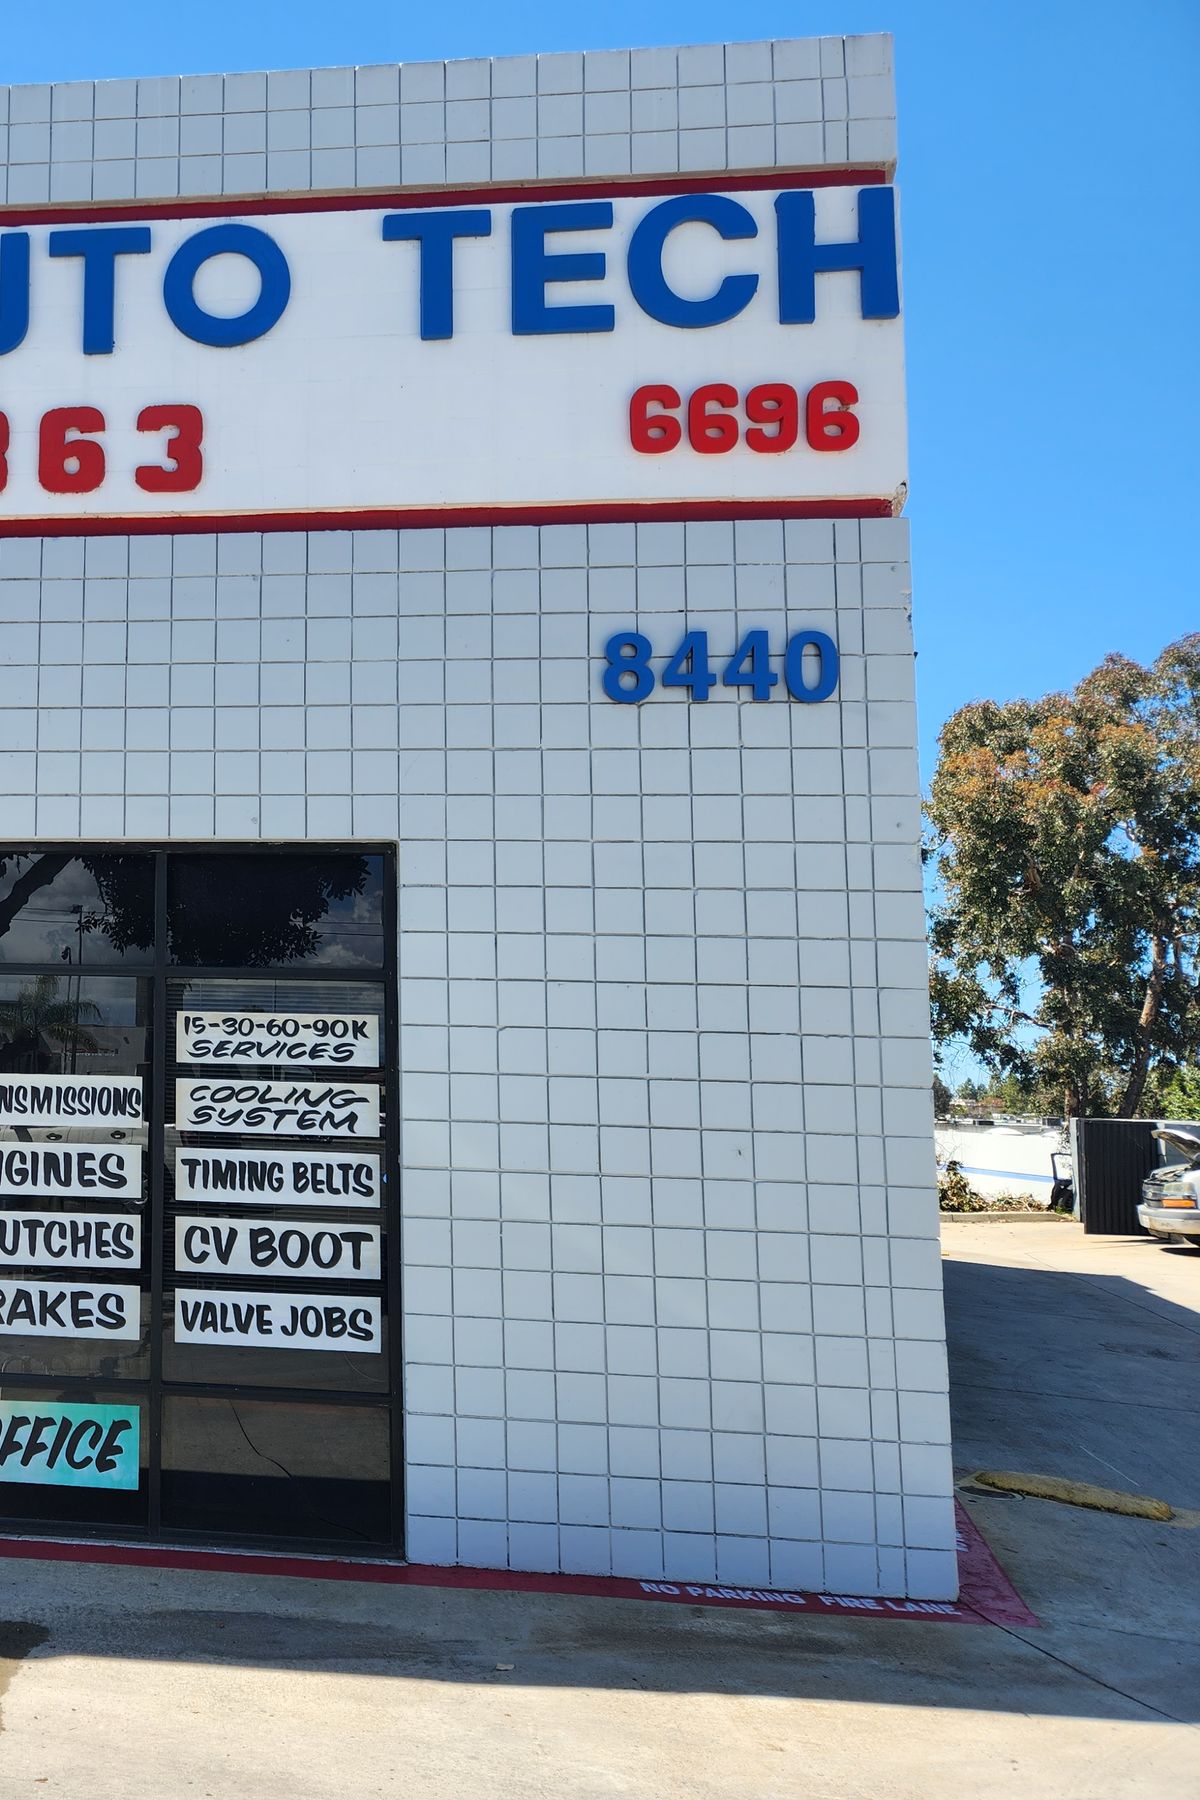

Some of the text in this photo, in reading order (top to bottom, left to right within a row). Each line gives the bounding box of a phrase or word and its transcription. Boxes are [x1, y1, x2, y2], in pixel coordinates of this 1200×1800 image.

[382, 186, 900, 340] TECH
[629, 381, 860, 454] 6696
[603, 630, 840, 703] 8440
[186, 1040, 356, 1062] SERVICES
[190, 1085, 370, 1109] COOLING
[187, 1105, 358, 1134] SYSTEM
[181, 1158, 374, 1197] TIMING BELTS
[184, 1226, 373, 1270] CV BOOT
[181, 1300, 373, 1341] VALVE JOBS
[640, 1582, 962, 1616] NO PARKING FIRE LANE
